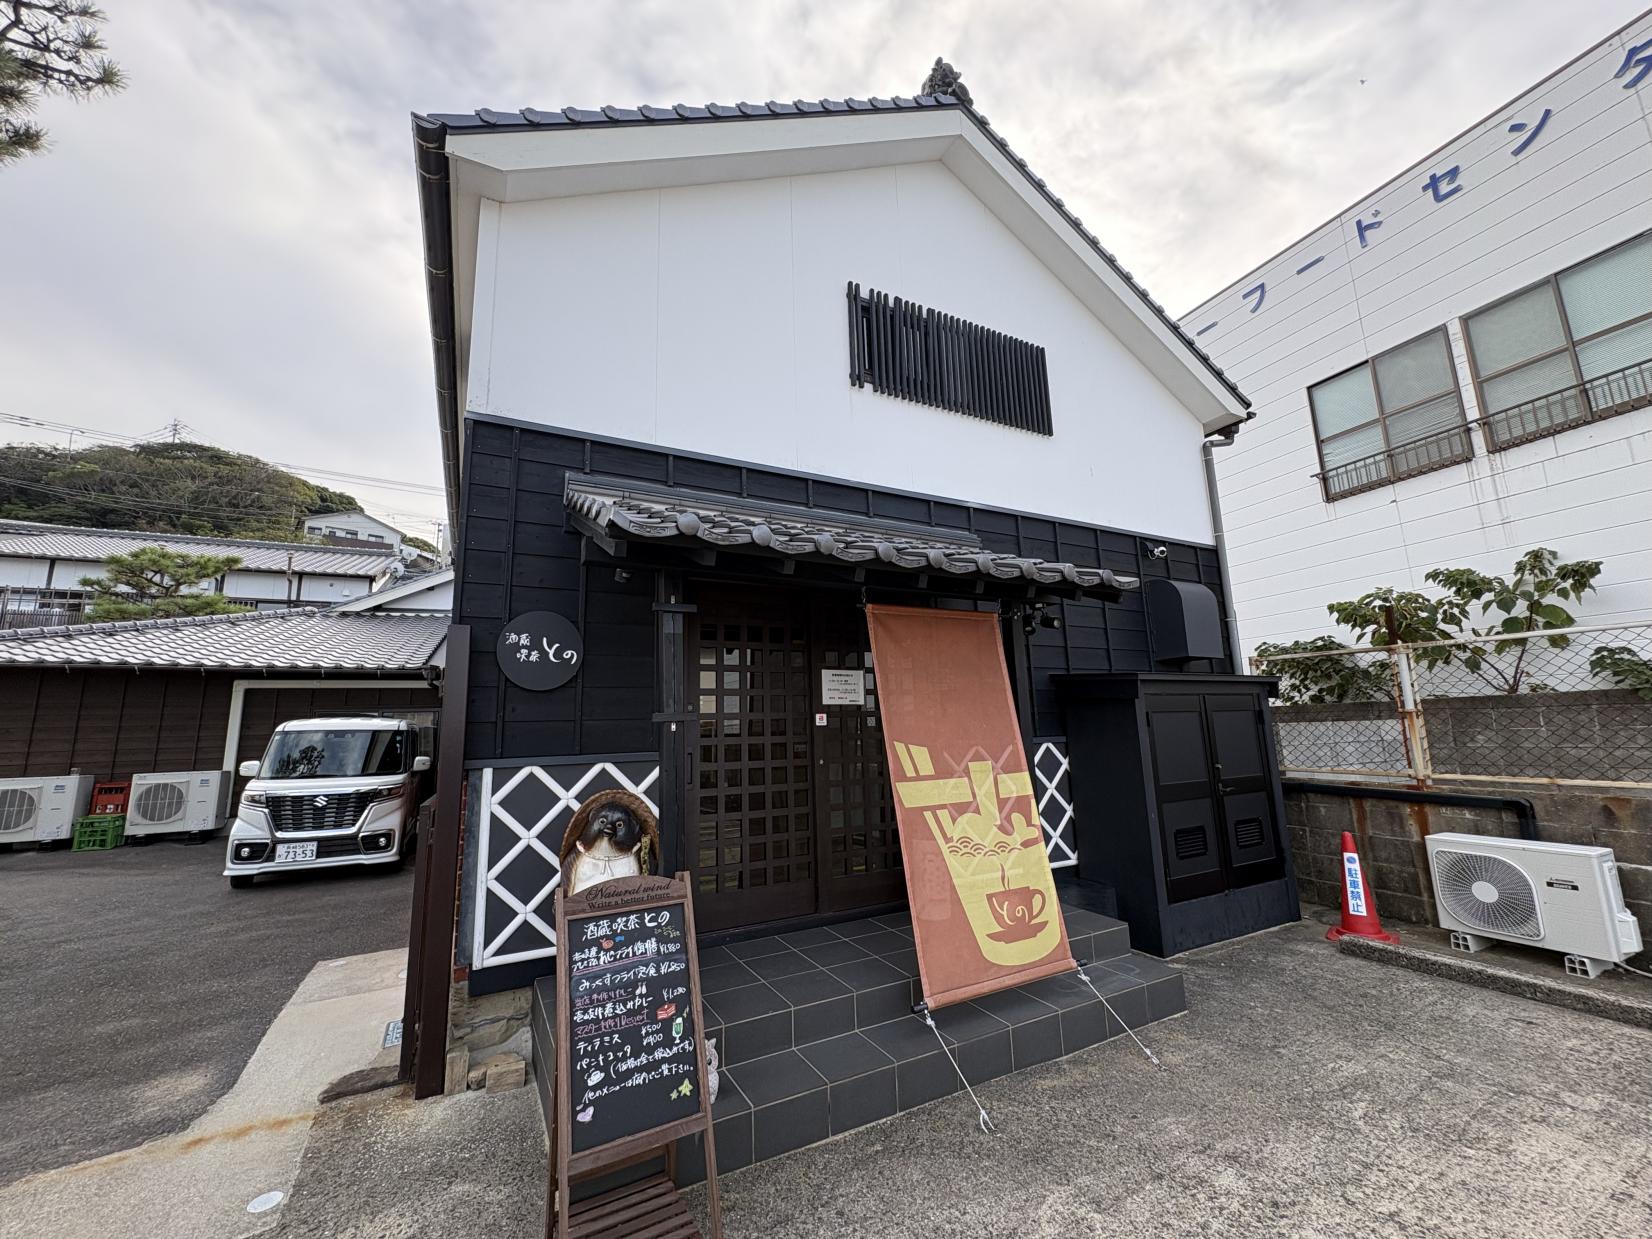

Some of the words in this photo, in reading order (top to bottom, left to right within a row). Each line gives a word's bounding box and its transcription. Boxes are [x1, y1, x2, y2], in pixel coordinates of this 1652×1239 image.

[543, 637, 577, 664] との
[284, 849, 315, 860] 73-53
[585, 883, 641, 901] Natural
[642, 881, 671, 893] wind
[1347, 867, 1364, 914] 駐車禁止
[587, 900, 614, 910] Write
[620, 895, 646, 905] better
[576, 1034, 622, 1055] ティラミス
[640, 1022, 662, 1037] ¥500
